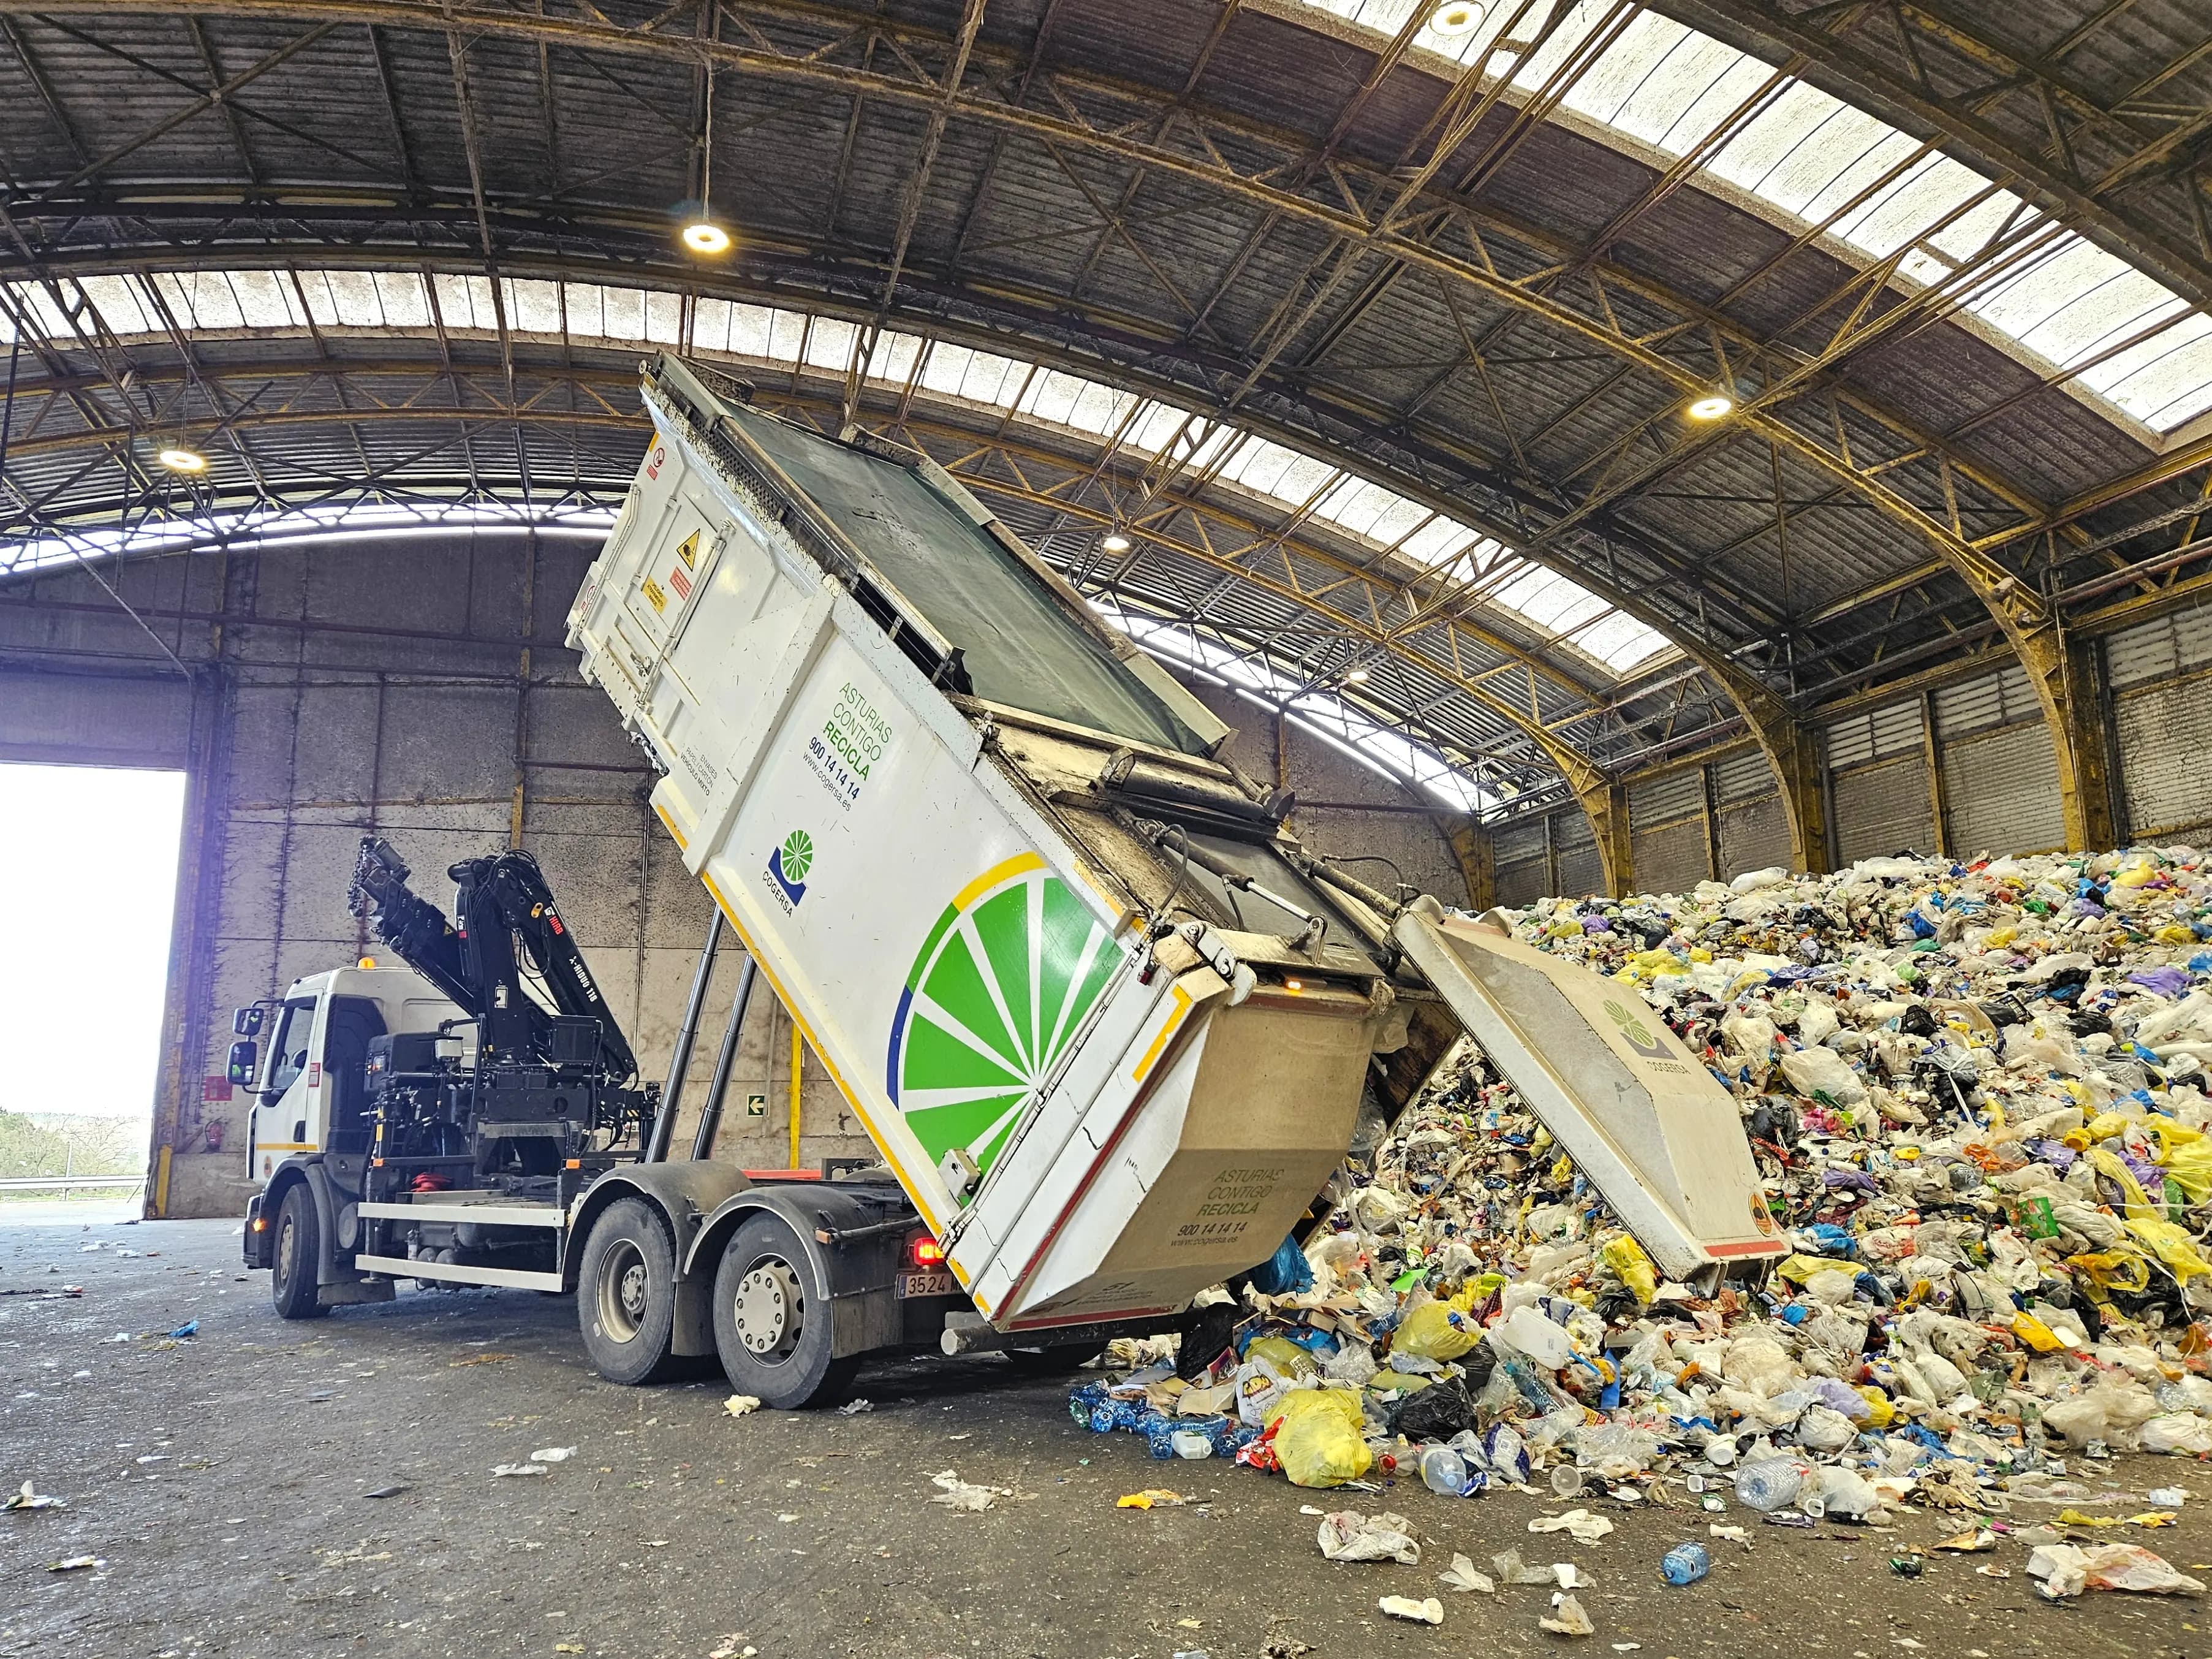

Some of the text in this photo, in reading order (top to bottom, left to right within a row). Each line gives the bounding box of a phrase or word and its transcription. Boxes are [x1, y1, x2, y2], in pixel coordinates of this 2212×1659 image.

[839, 682, 892, 743] ASTURIAS
[833, 703, 881, 761] CONTIGO
[823, 720, 869, 781] RECICLA
[700, 754, 718, 780] ENVASES
[809, 737, 860, 800] 900 14 14 14
[698, 777, 710, 796] MIXTO
[803, 752, 852, 811] www.cogersa.es
[763, 871, 792, 918] COGERSA
[549, 916, 564, 935] HIAB
[586, 987, 598, 1003] 118
[1646, 1061, 1691, 1075] COGERSA
[1213, 1169, 1284, 1183] ASTURIAS
[1208, 1185, 1273, 1200] CONTIGO
[1196, 1202, 1260, 1217] RECICLA
[1178, 1221, 1248, 1236] 900 14 14 14
[909, 1276, 945, 1294] 3524
